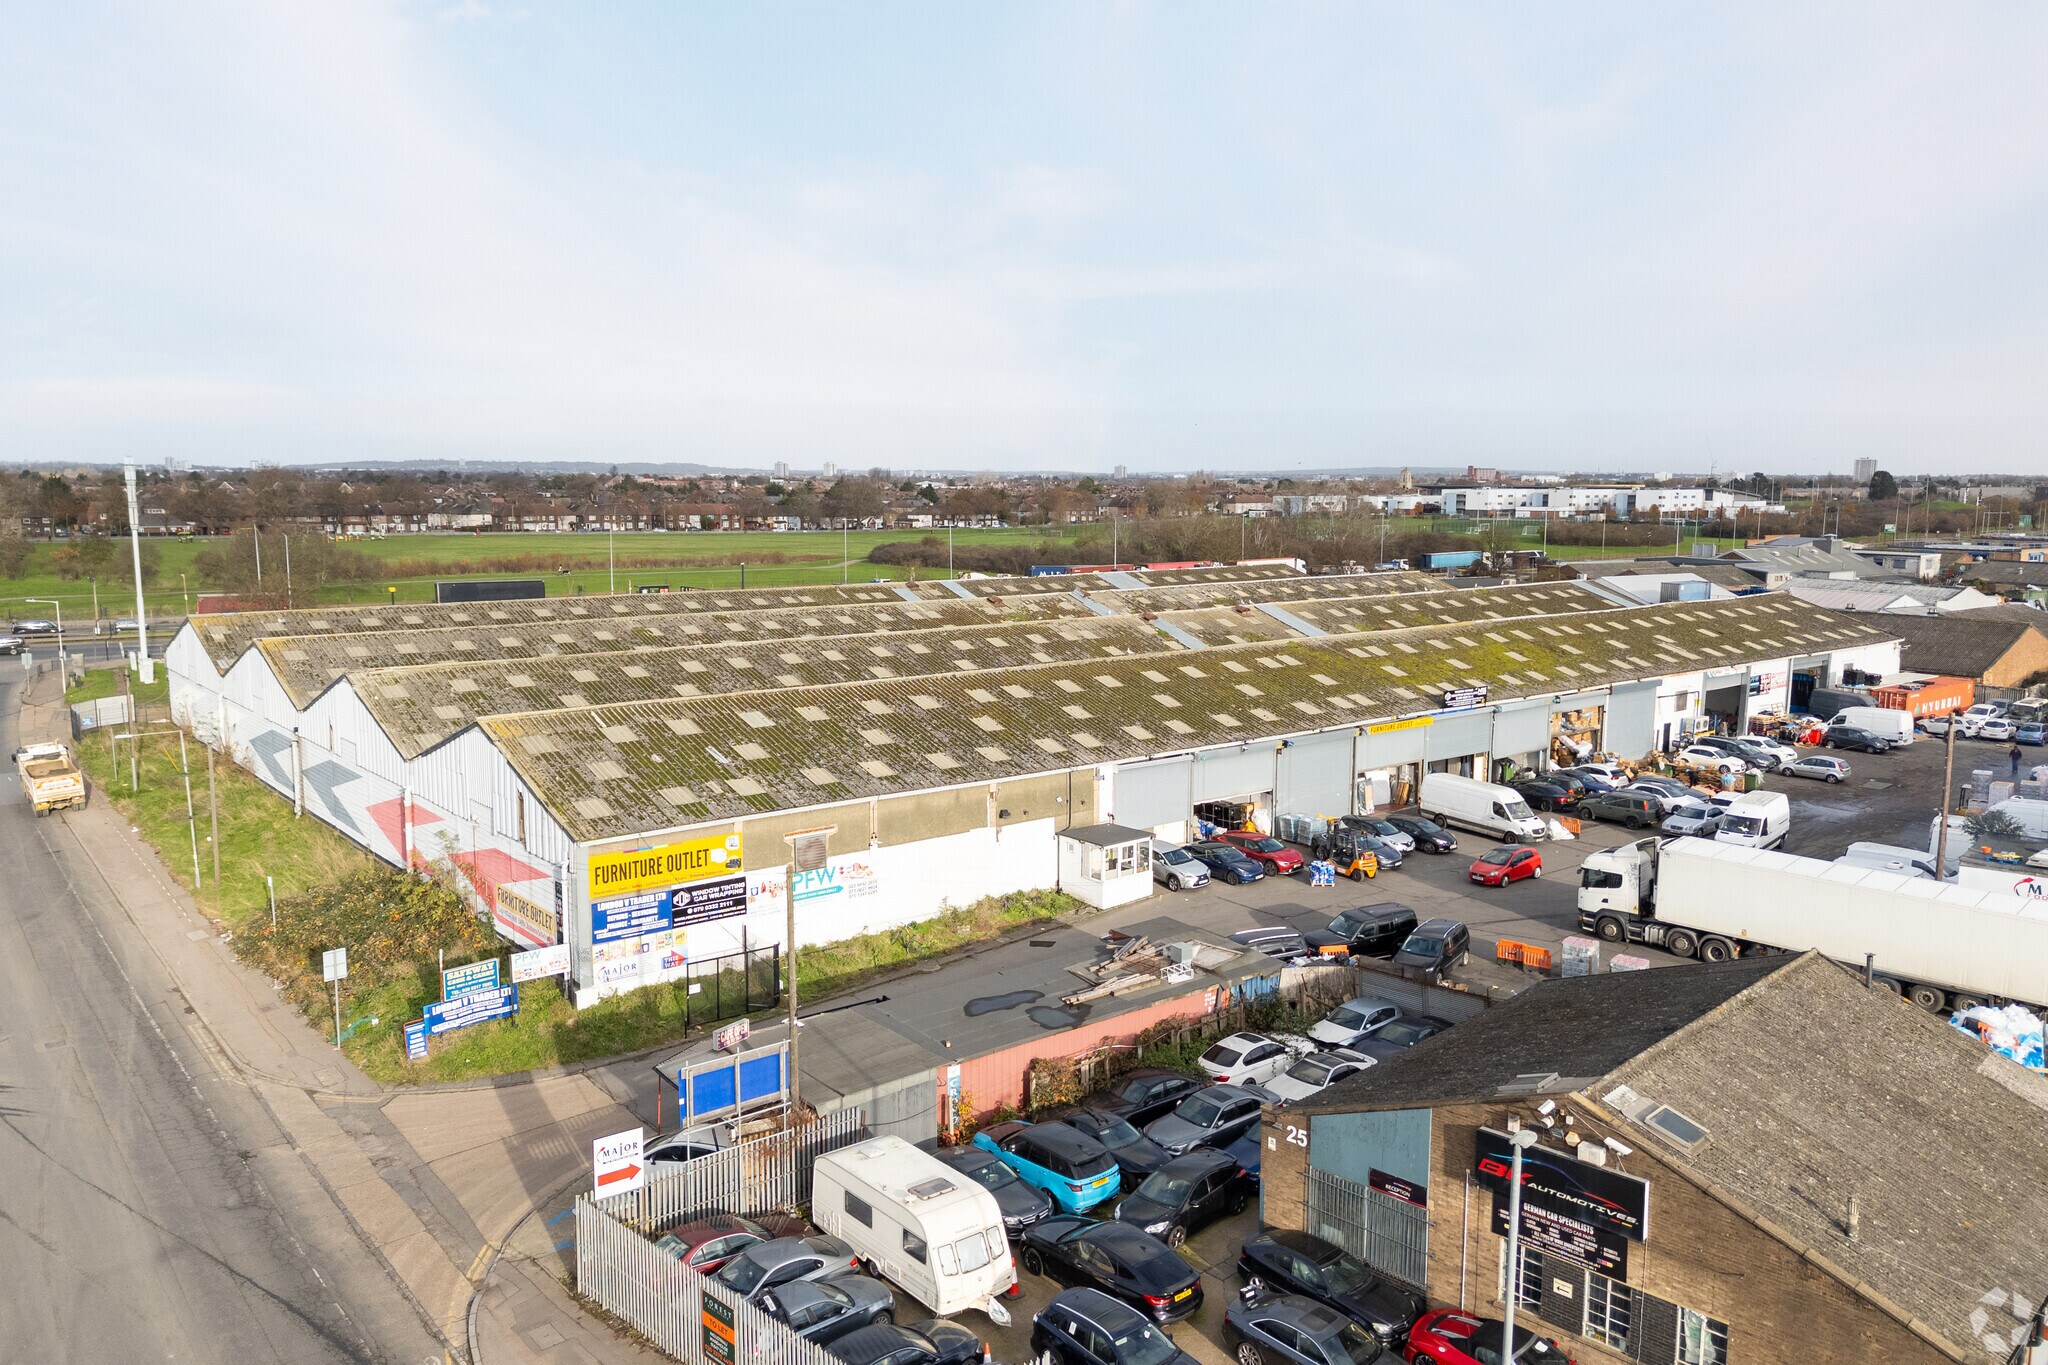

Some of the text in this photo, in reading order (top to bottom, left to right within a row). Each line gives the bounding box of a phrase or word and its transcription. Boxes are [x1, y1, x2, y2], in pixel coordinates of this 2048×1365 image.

[1922, 695, 1961, 713] HYUNDAI
[1370, 723, 1396, 733] FURNITURE
[1396, 721, 1413, 730] OUTLET
[594, 848, 709, 885] FURNITURE OUTLET
[792, 866, 836, 892] PFW
[692, 882, 746, 897] WINDOW TINTING
[693, 888, 744, 902] CAR WRAPPING
[497, 886, 530, 918] FURNITURE
[530, 905, 553, 930] OUTLET
[597, 899, 624, 912] LONDON
[629, 894, 655, 906] TRADER
[655, 892, 667, 901] LTD
[514, 950, 541, 964] PFW
[664, 955, 679, 963] THIS
[664, 960, 679, 969] WAY
[432, 997, 463, 1016] LONDON
[468, 989, 500, 1004] TRADER
[1286, 1125, 1308, 1148] 25
[1478, 1158, 1533, 1186] BK
[1385, 1184, 1411, 1198] RECEPTION
[1521, 1211, 1540, 1222] GERMAN
[1540, 1216, 1551, 1225] NEW
[1551, 1219, 1561, 1230] AND
[1560, 1223, 1573, 1234] USED
[1573, 1229, 1582, 1238] CAR
[1523, 1202, 1547, 1219] GERMAN
[1546, 1210, 1559, 1222] CAR
[1558, 1214, 1595, 1235] SPECIALISTS
[704, 1296, 732, 1319] FOREST
[709, 1318, 728, 1336] TO LET
